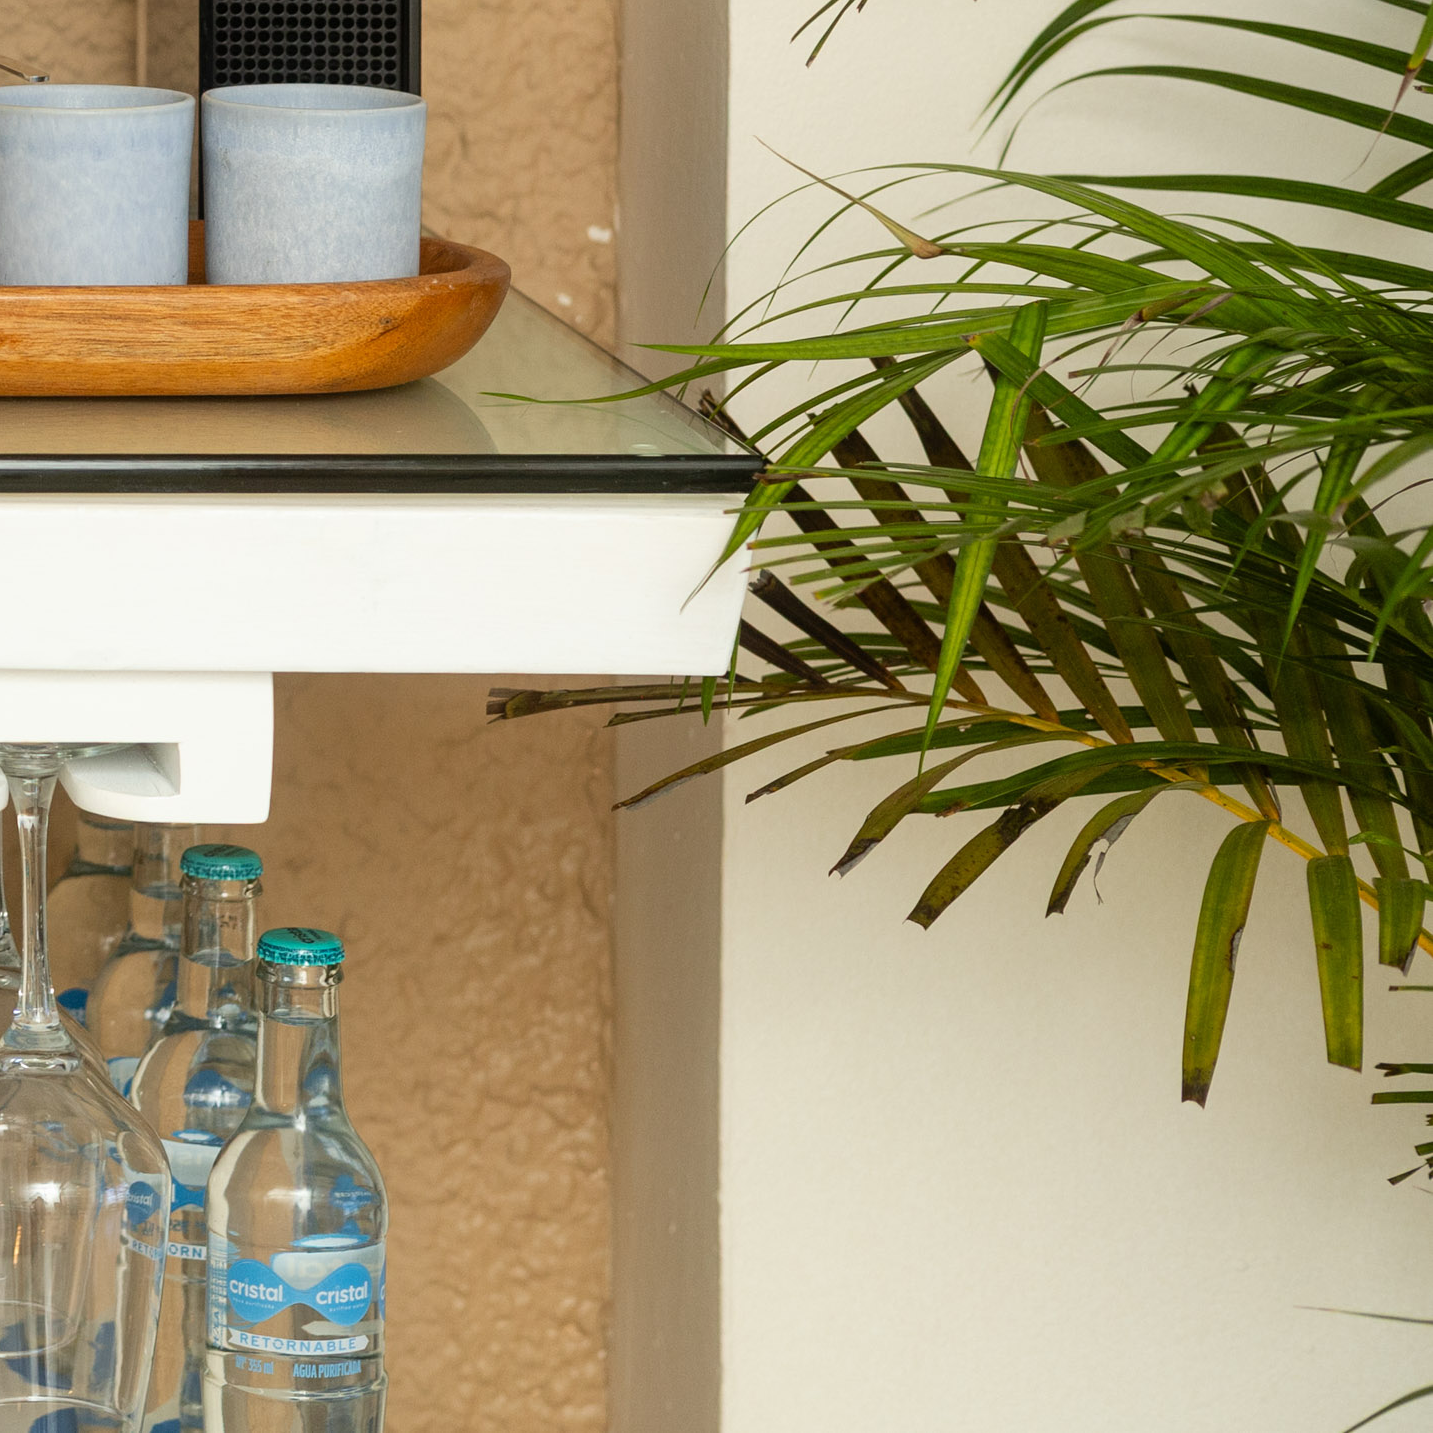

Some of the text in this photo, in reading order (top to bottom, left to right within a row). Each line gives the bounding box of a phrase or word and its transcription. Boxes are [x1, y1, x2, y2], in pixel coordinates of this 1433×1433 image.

[168, 1243, 205, 1259] ORN
[229, 1278, 284, 1303] cristal
[316, 1281, 368, 1305] cristal
[239, 1331, 357, 1354] RETORNABLE
[248, 1358, 262, 1373] 355
[293, 1360, 362, 1379] AGUA PURIFICADA
